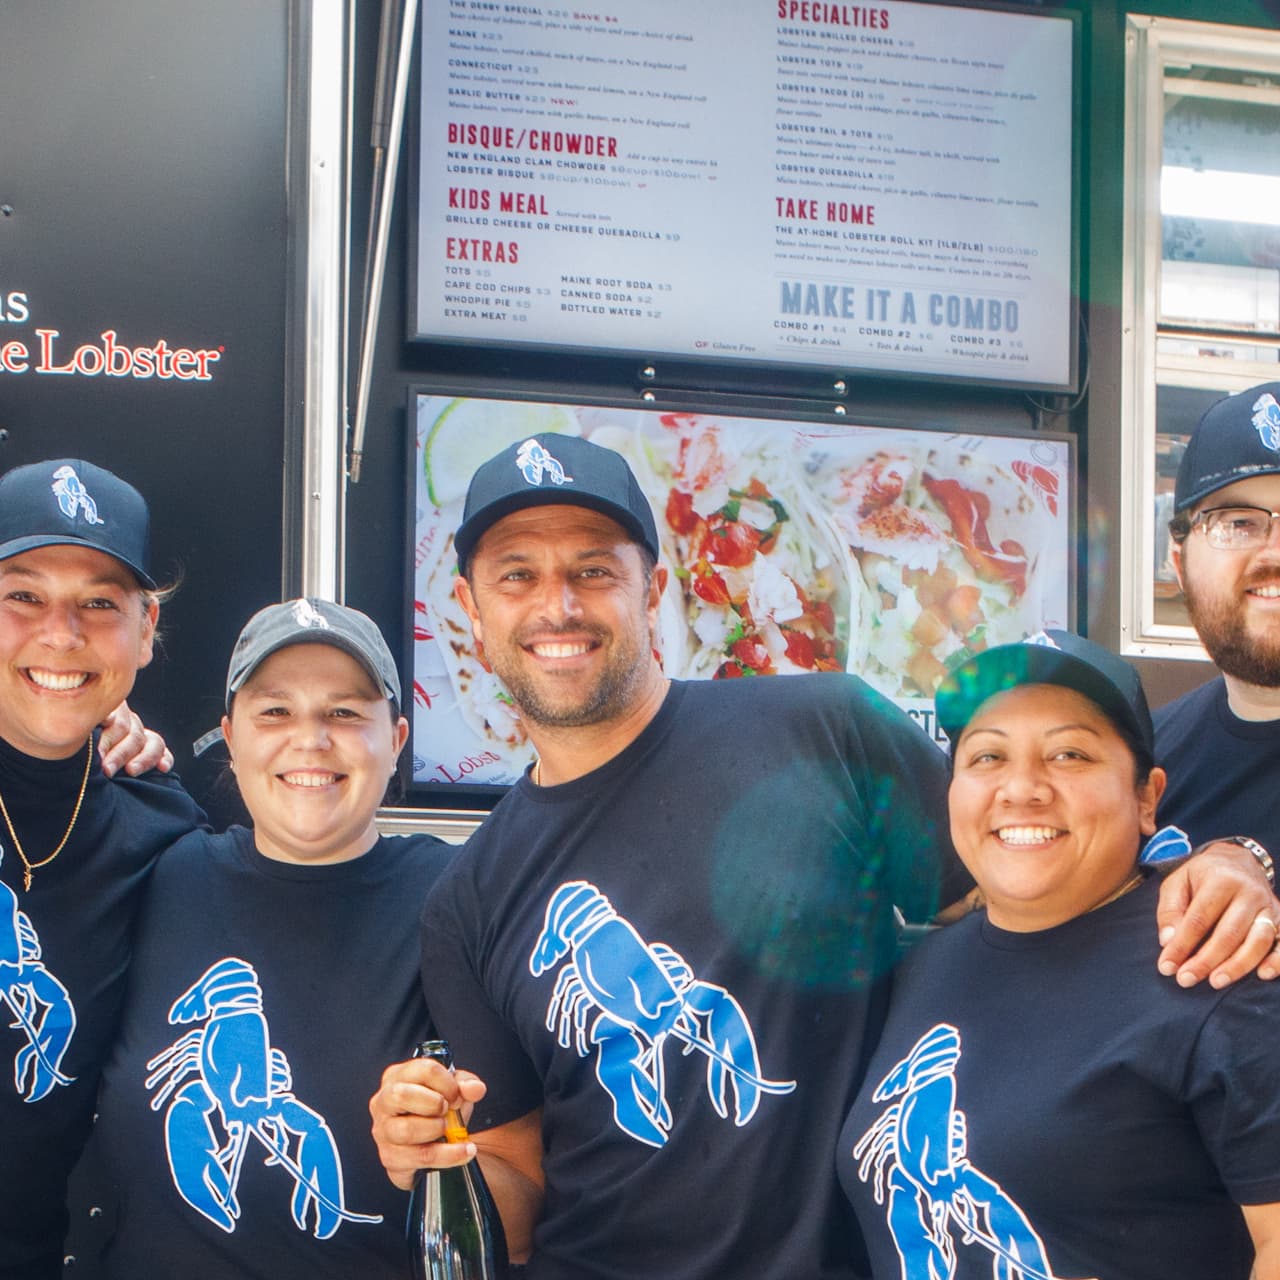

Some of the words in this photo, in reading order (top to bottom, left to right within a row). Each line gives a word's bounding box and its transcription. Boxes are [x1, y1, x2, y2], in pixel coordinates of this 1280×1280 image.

[470, 2, 500, 11] DERBY
[504, 5, 543, 16] SPECIAL
[778, 0, 889, 30] SPECIALTIES
[449, 29, 477, 39] MAINE
[777, 27, 817, 38] LOBSTER
[820, 31, 857, 43] GRILLED
[860, 35, 894, 46] CHEESE
[448, 59, 513, 71] CONNECTICUT
[776, 55, 816, 66] LOBSTER
[820, 59, 842, 69] TOTS
[448, 87, 482, 98] GARLIC
[486, 91, 521, 101] BUTTER
[776, 83, 816, 93] LOBSTER
[820, 87, 848, 98] TACOS
[776, 123, 816, 134] LOBSTER
[820, 126, 838, 137] TAIL
[851, 130, 873, 139] TOTS
[448, 122, 618, 159] BISQUE/CHOWDER
[447, 151, 469, 160] NEW
[474, 152, 521, 165] ENGLAND
[525, 156, 552, 167] CLAM
[557, 160, 606, 171] CHOWDER
[447, 165, 493, 176] LOBSTER
[497, 169, 535, 180] BISQUE
[776, 163, 816, 174] LOBSTER
[819, 166, 874, 179] QUESADILLA
[449, 187, 491, 211] KIDS
[500, 191, 549, 216] MEAL
[776, 196, 818, 221] TAKE
[827, 200, 875, 226] HOME
[446, 215, 489, 226] GRILLED
[493, 219, 532, 230] CHEESE
[537, 222, 551, 231] OR
[554, 223, 594, 234] CHEESE
[598, 227, 662, 240] QUESADILLA
[776, 225, 793, 235] THE
[797, 228, 839, 239] AT-HOME
[843, 231, 886, 243] LOBSTER
[890, 235, 915, 246] ROLL
[918, 238, 933, 247] KIT
[447, 237, 519, 265] EXTRAS
[445, 266, 472, 276] TOTS
[444, 280, 472, 290] CAPE
[475, 282, 497, 292] COD
[500, 284, 531, 295] CHIPS
[560, 275, 592, 286] MAINE
[596, 278, 622, 288] ROOT
[626, 280, 654, 291] SODA
[444, 295, 491, 306] WHOOPIE
[495, 298, 511, 308] PIE
[560, 289, 602, 300] CANNED
[605, 293, 633, 303] SODA
[444, 308, 478, 319] EXTRA
[481, 311, 507, 321] MEAT
[560, 303, 606, 315] BOTTLED
[609, 307, 642, 318] WATER
[781, 280, 856, 320] MAKE
[866, 287, 892, 322] IT
[899, 291, 918, 325] A
[929, 293, 1020, 334] COMBO
[774, 320, 809, 331] COMBO
[813, 323, 825, 332] #1
[859, 327, 894, 338] COMBO
[898, 330, 911, 340] #2
[739, 343, 757, 353] Free
[787, 335, 810, 346] Chips
[820, 337, 841, 347] drink
[950, 334, 985, 346] COMBO
[988, 338, 1002, 347] #3
[35, 329, 221, 381] Lobster
[903, 344, 924, 353] drink
[952, 348, 984, 360] Whoopie
[986, 351, 998, 361] pie
[1009, 353, 1030, 362] drink
